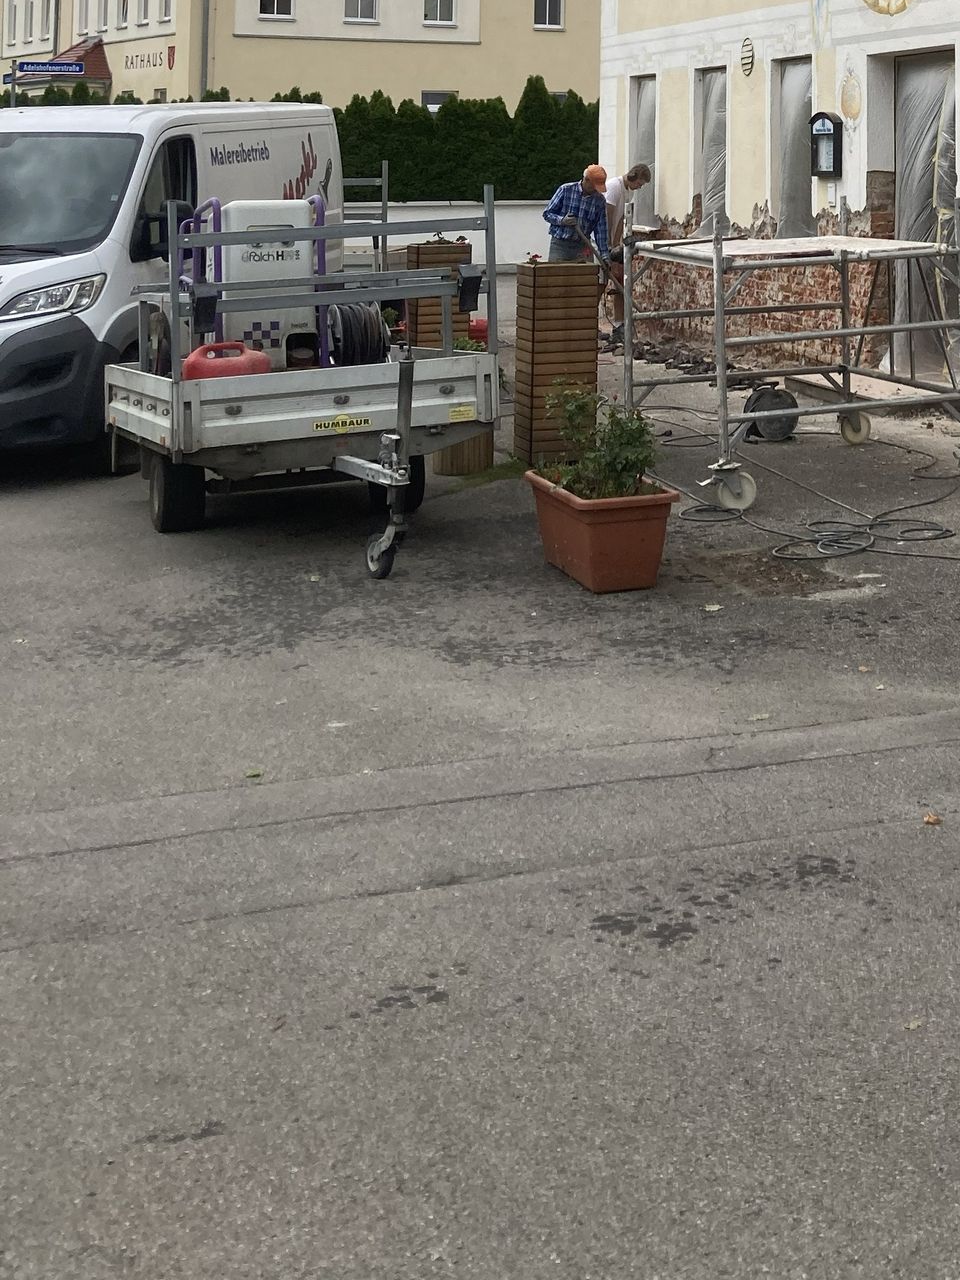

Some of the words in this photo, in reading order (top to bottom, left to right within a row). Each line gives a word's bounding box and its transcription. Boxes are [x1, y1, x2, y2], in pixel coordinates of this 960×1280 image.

[124, 51, 164, 70] RATHAUS
[209, 140, 270, 167] Malereibetrieb
[315, 418, 370, 430] HUMBAUR
